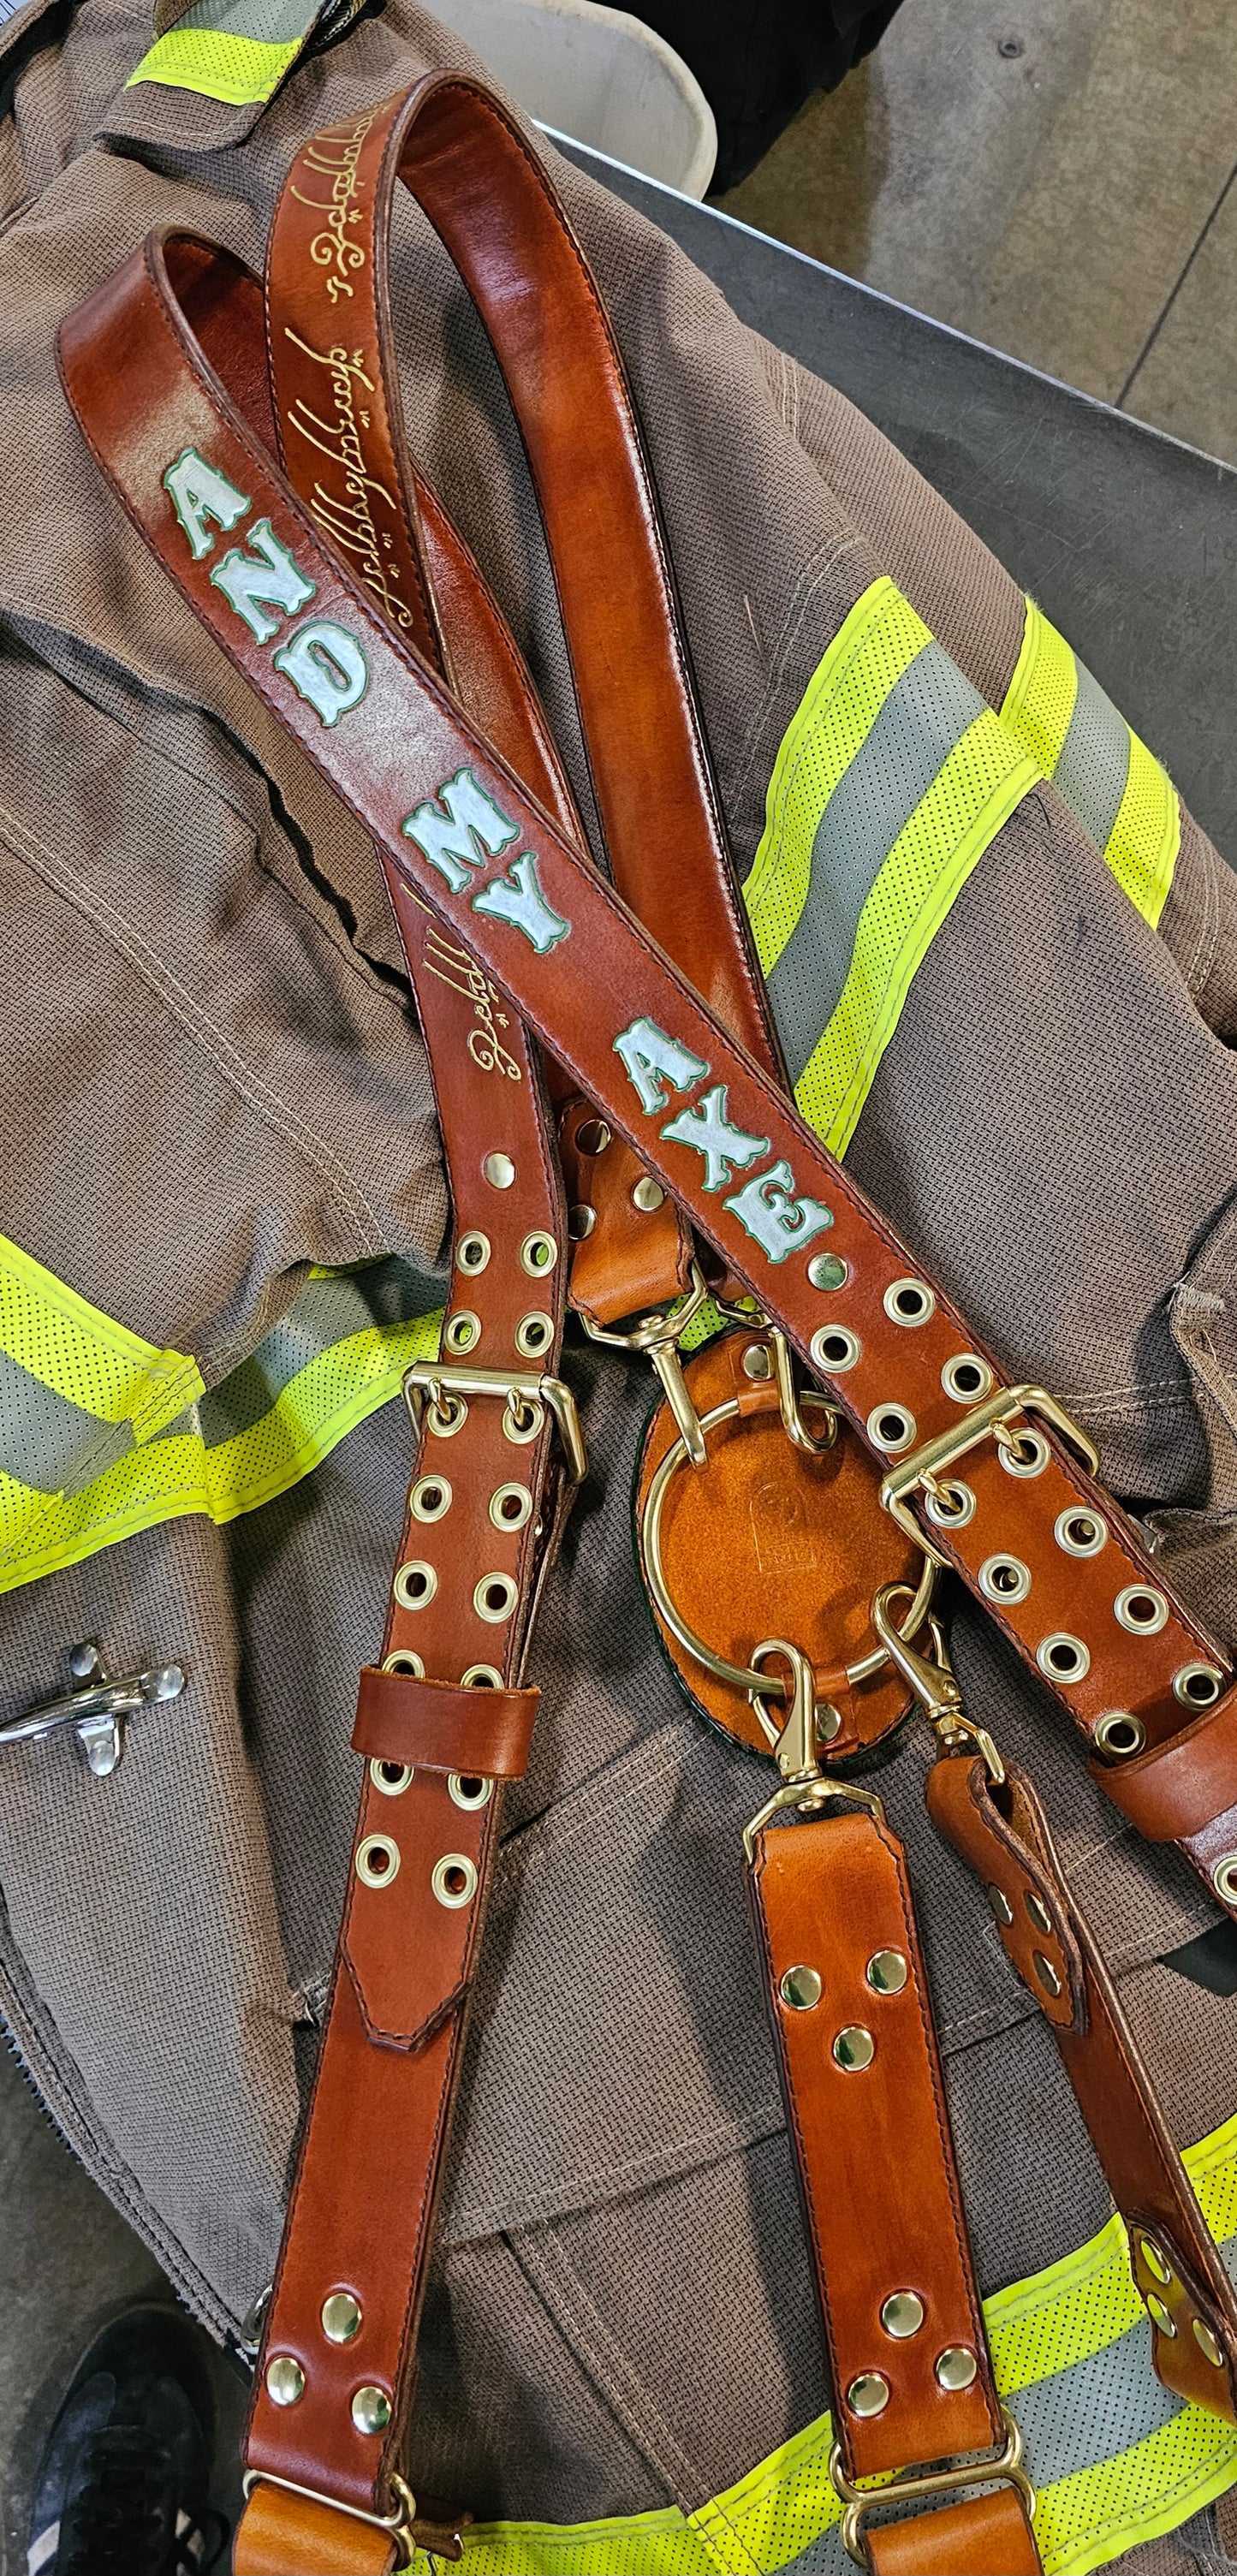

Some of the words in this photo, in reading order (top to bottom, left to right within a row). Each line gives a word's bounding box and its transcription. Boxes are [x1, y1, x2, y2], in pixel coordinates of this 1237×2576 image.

[164, 447, 370, 728] AND
[401, 767, 569, 954] MY
[612, 1015, 835, 1264] AXE
